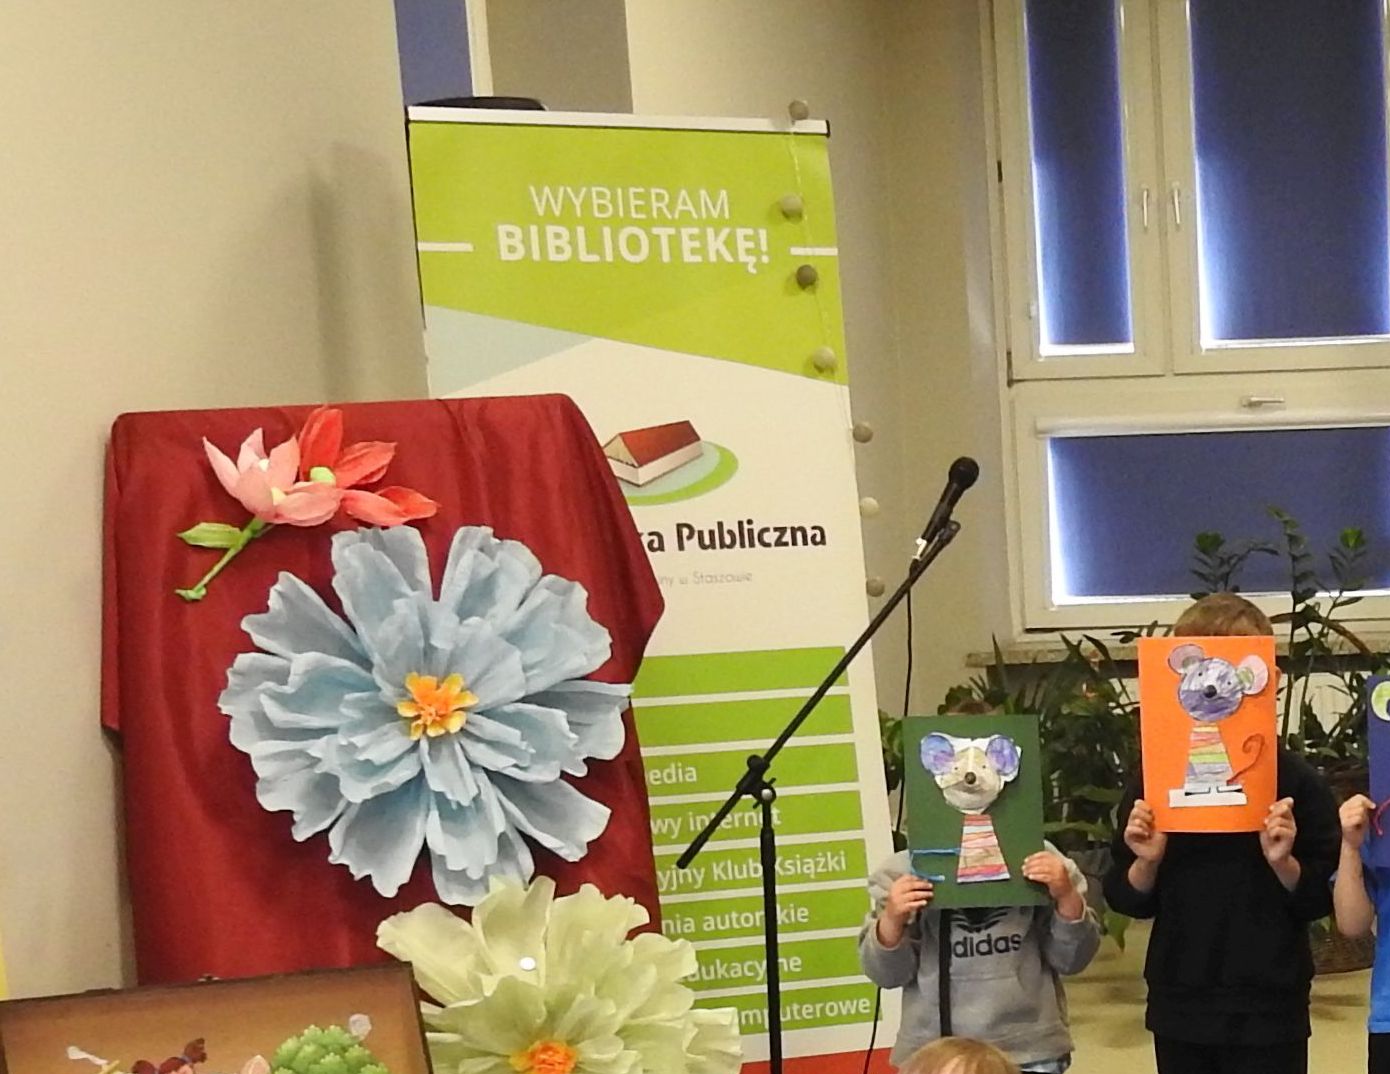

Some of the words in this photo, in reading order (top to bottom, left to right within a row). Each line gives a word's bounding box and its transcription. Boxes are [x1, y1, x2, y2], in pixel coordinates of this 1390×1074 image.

[529, 185, 730, 219] WYBIERAM
[497, 225, 770, 273] BIBLIOTEKĘ!
[676, 518, 827, 551] Publiczna
[688, 807, 782, 832] inernt
[712, 858, 762, 881] Klub
[702, 904, 809, 932] autorkie
[952, 932, 1022, 958] didas
[740, 998, 871, 1029] muterowe
